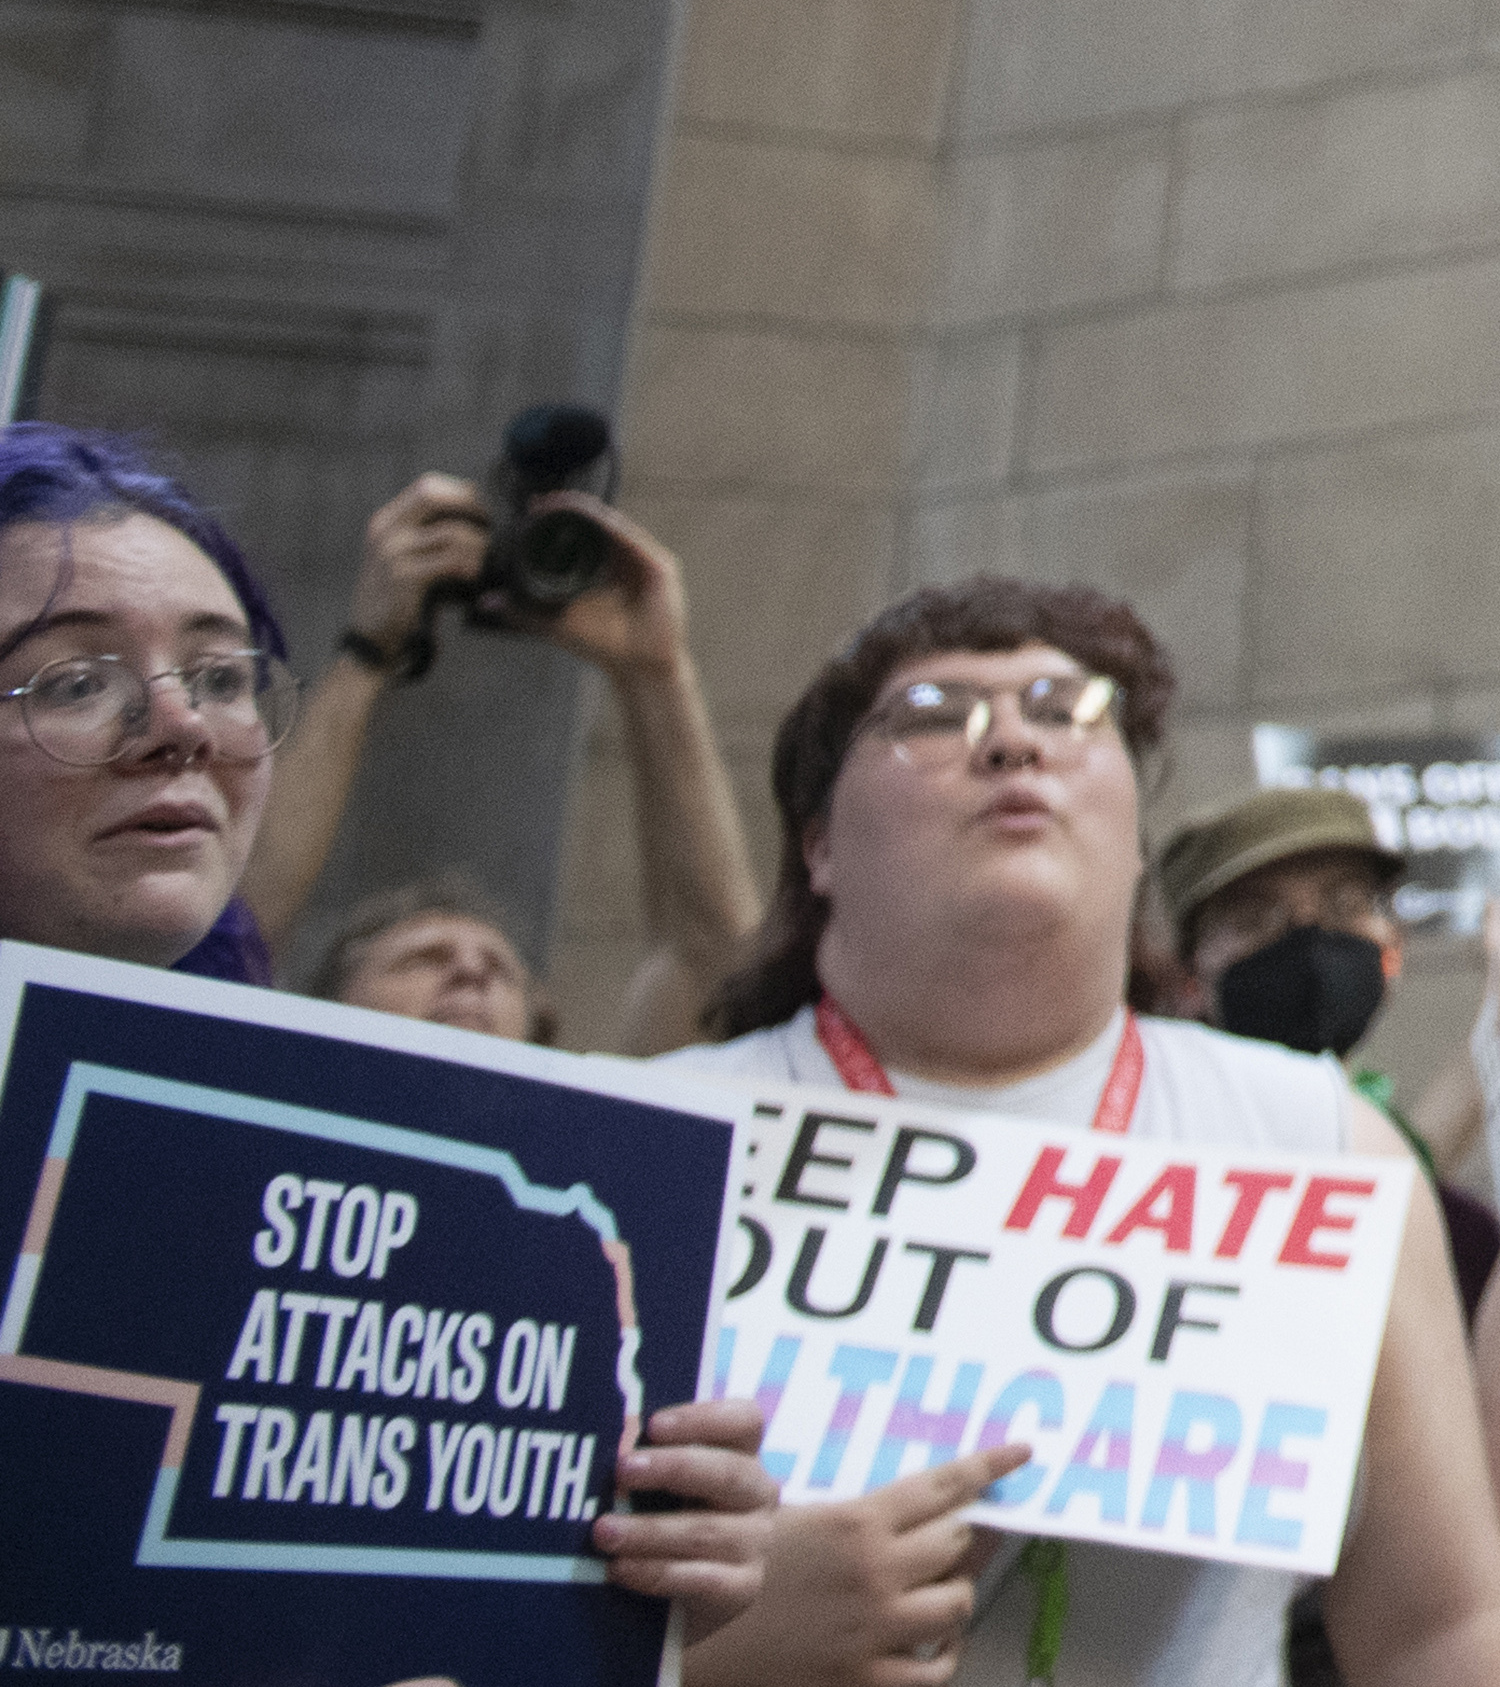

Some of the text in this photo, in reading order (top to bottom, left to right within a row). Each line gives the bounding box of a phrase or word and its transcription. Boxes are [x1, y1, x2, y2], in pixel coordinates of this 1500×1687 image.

[252, 1172, 418, 1281] STOP
[740, 1100, 1377, 1273] EP HATE
[225, 1288, 577, 1412] ATTACKS ON
[1030, 1266, 1242, 1364] OF
[211, 1403, 600, 1522] TRANS YOUTH.
[711, 1326, 1329, 1553] LTHCARE
[11, 1627, 183, 1672] Nebraska
